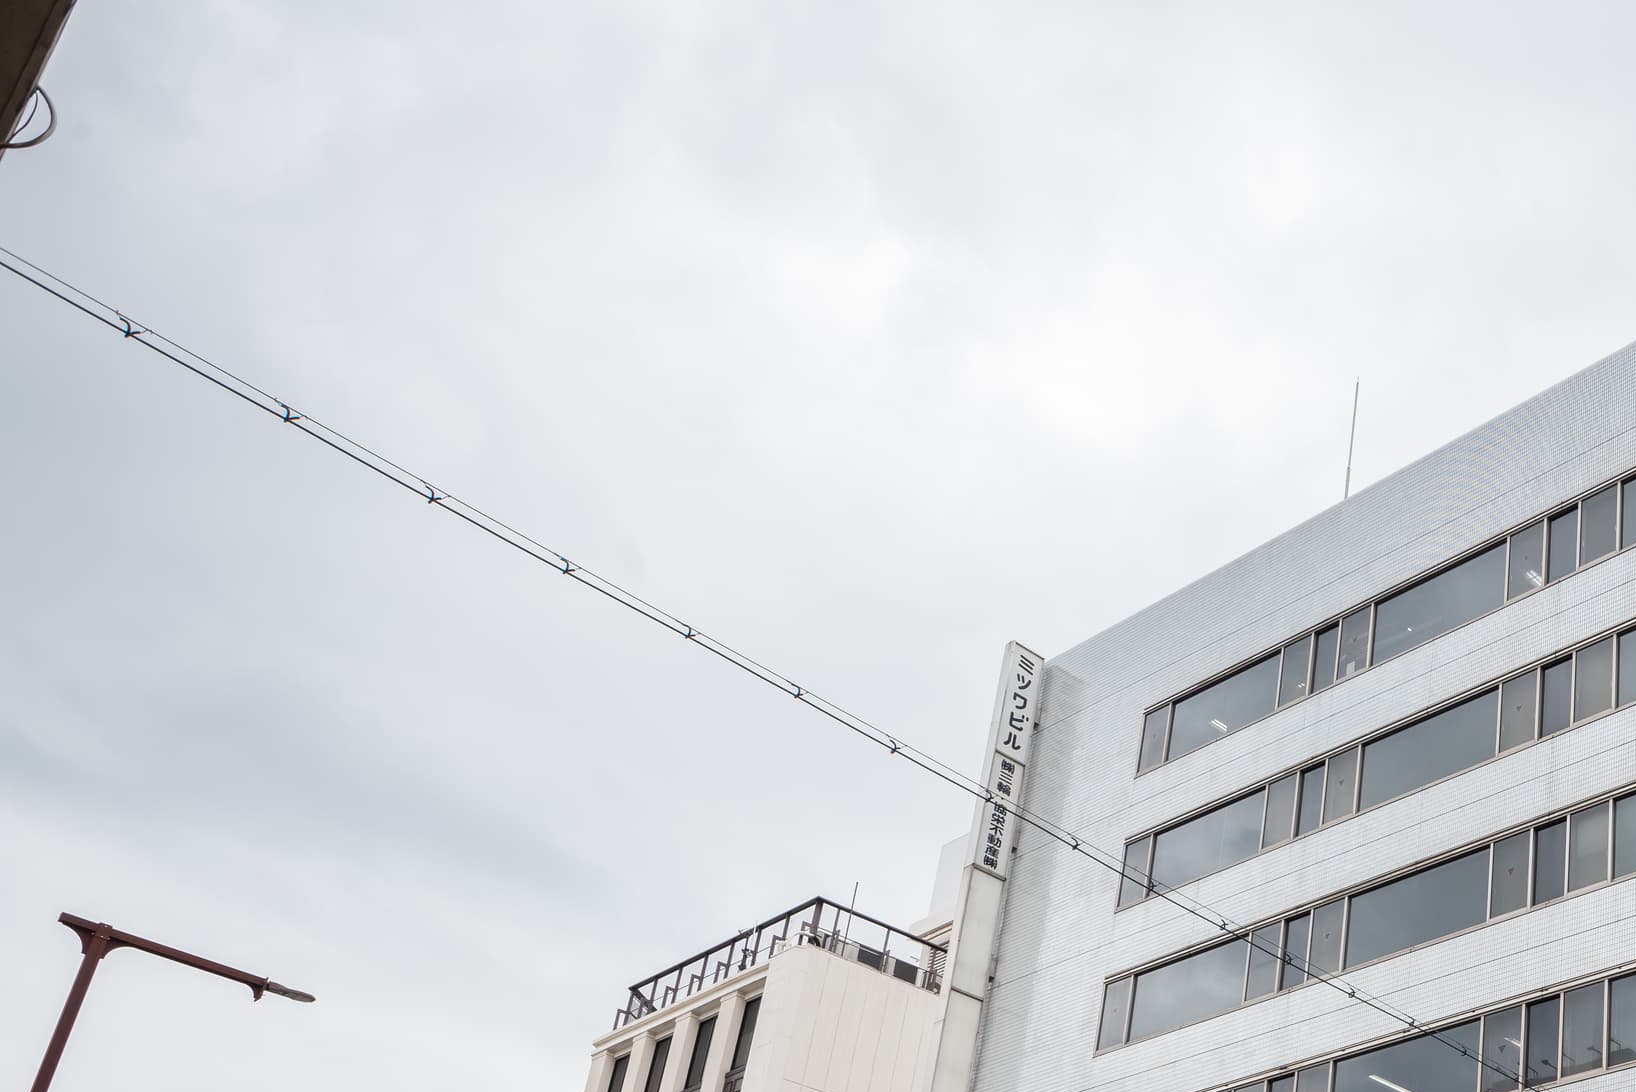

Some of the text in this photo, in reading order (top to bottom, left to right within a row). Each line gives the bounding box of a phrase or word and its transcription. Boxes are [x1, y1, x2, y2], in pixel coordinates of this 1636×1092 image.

[1003, 654, 1035, 750] ミツワビル
